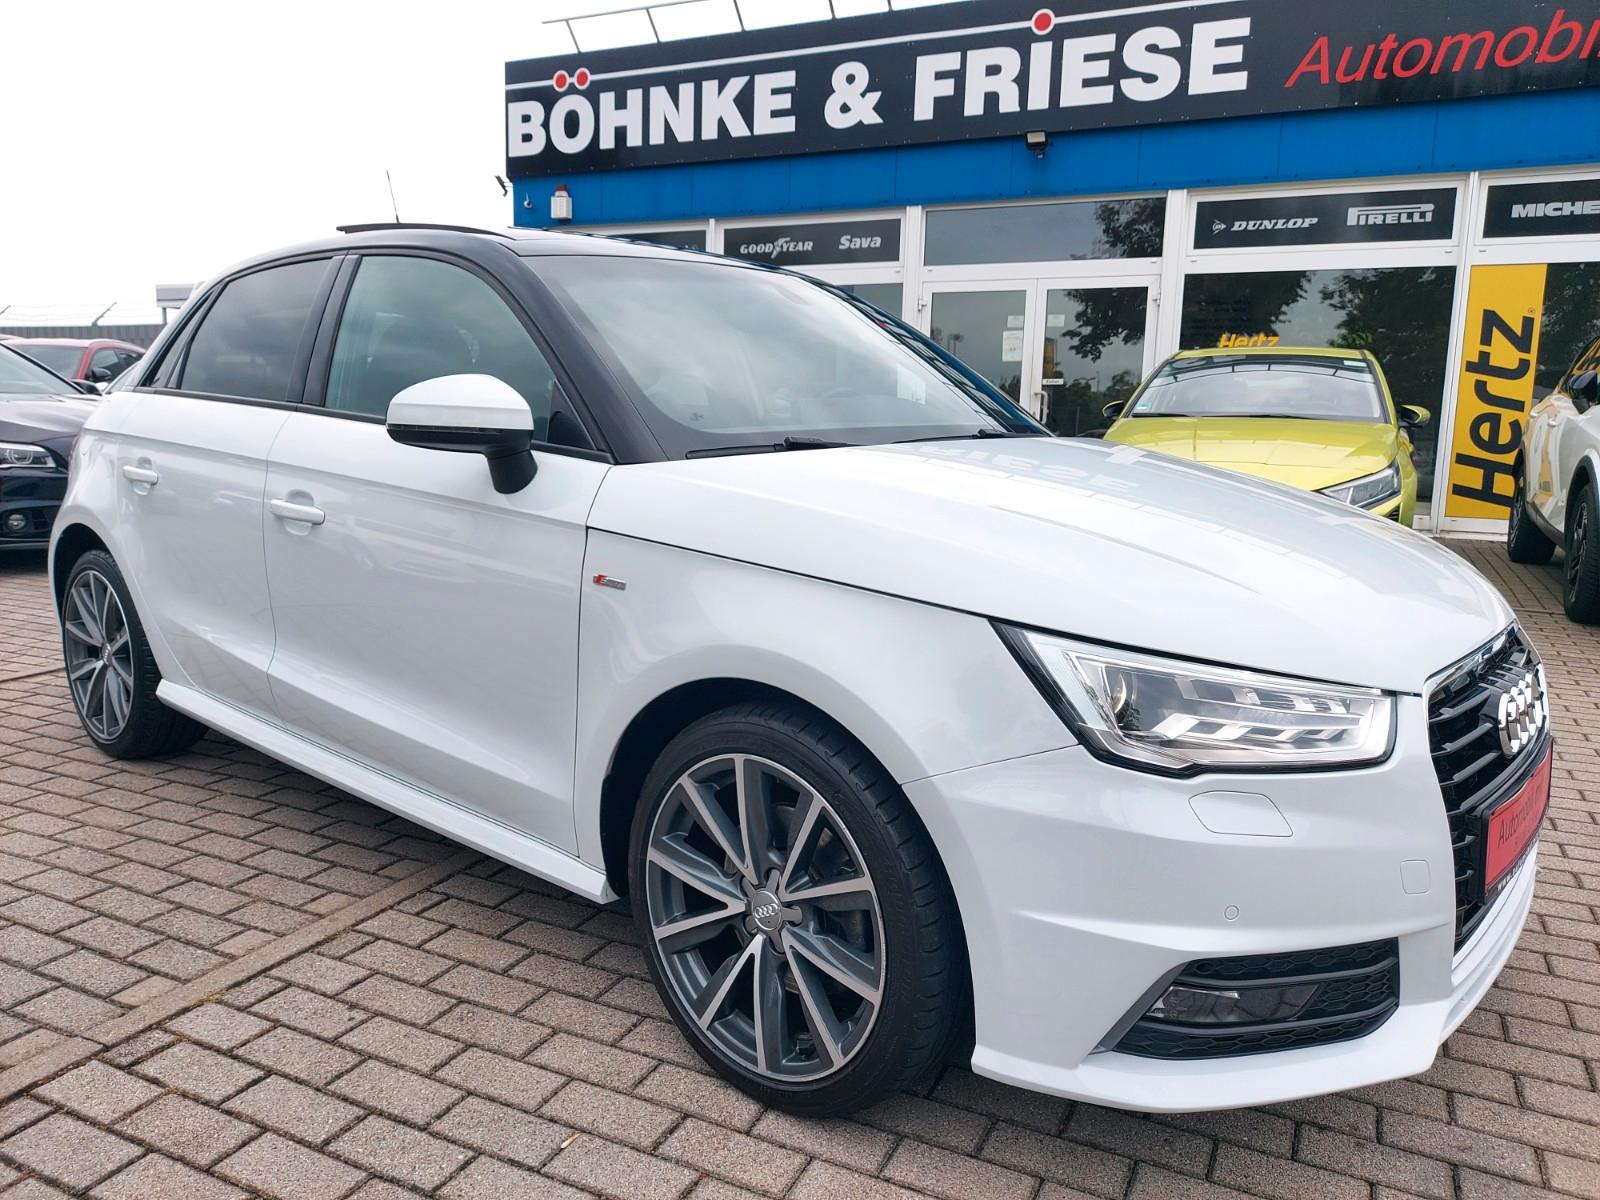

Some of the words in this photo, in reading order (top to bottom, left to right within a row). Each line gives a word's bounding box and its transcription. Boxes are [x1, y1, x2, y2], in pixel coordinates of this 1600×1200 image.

[507, 68, 796, 158] BÖHNKE
[824, 61, 884, 129] &
[914, 9, 1251, 121] FRIESE
[1285, 9, 1600, 87] Automobi
[1230, 217, 1318, 231] DUNLOP
[1347, 203, 1435, 225] PIRELLI
[838, 235, 882, 249] Sava
[1217, 332, 1280, 347] Hertz
[1452, 308, 1534, 508] Hertz
